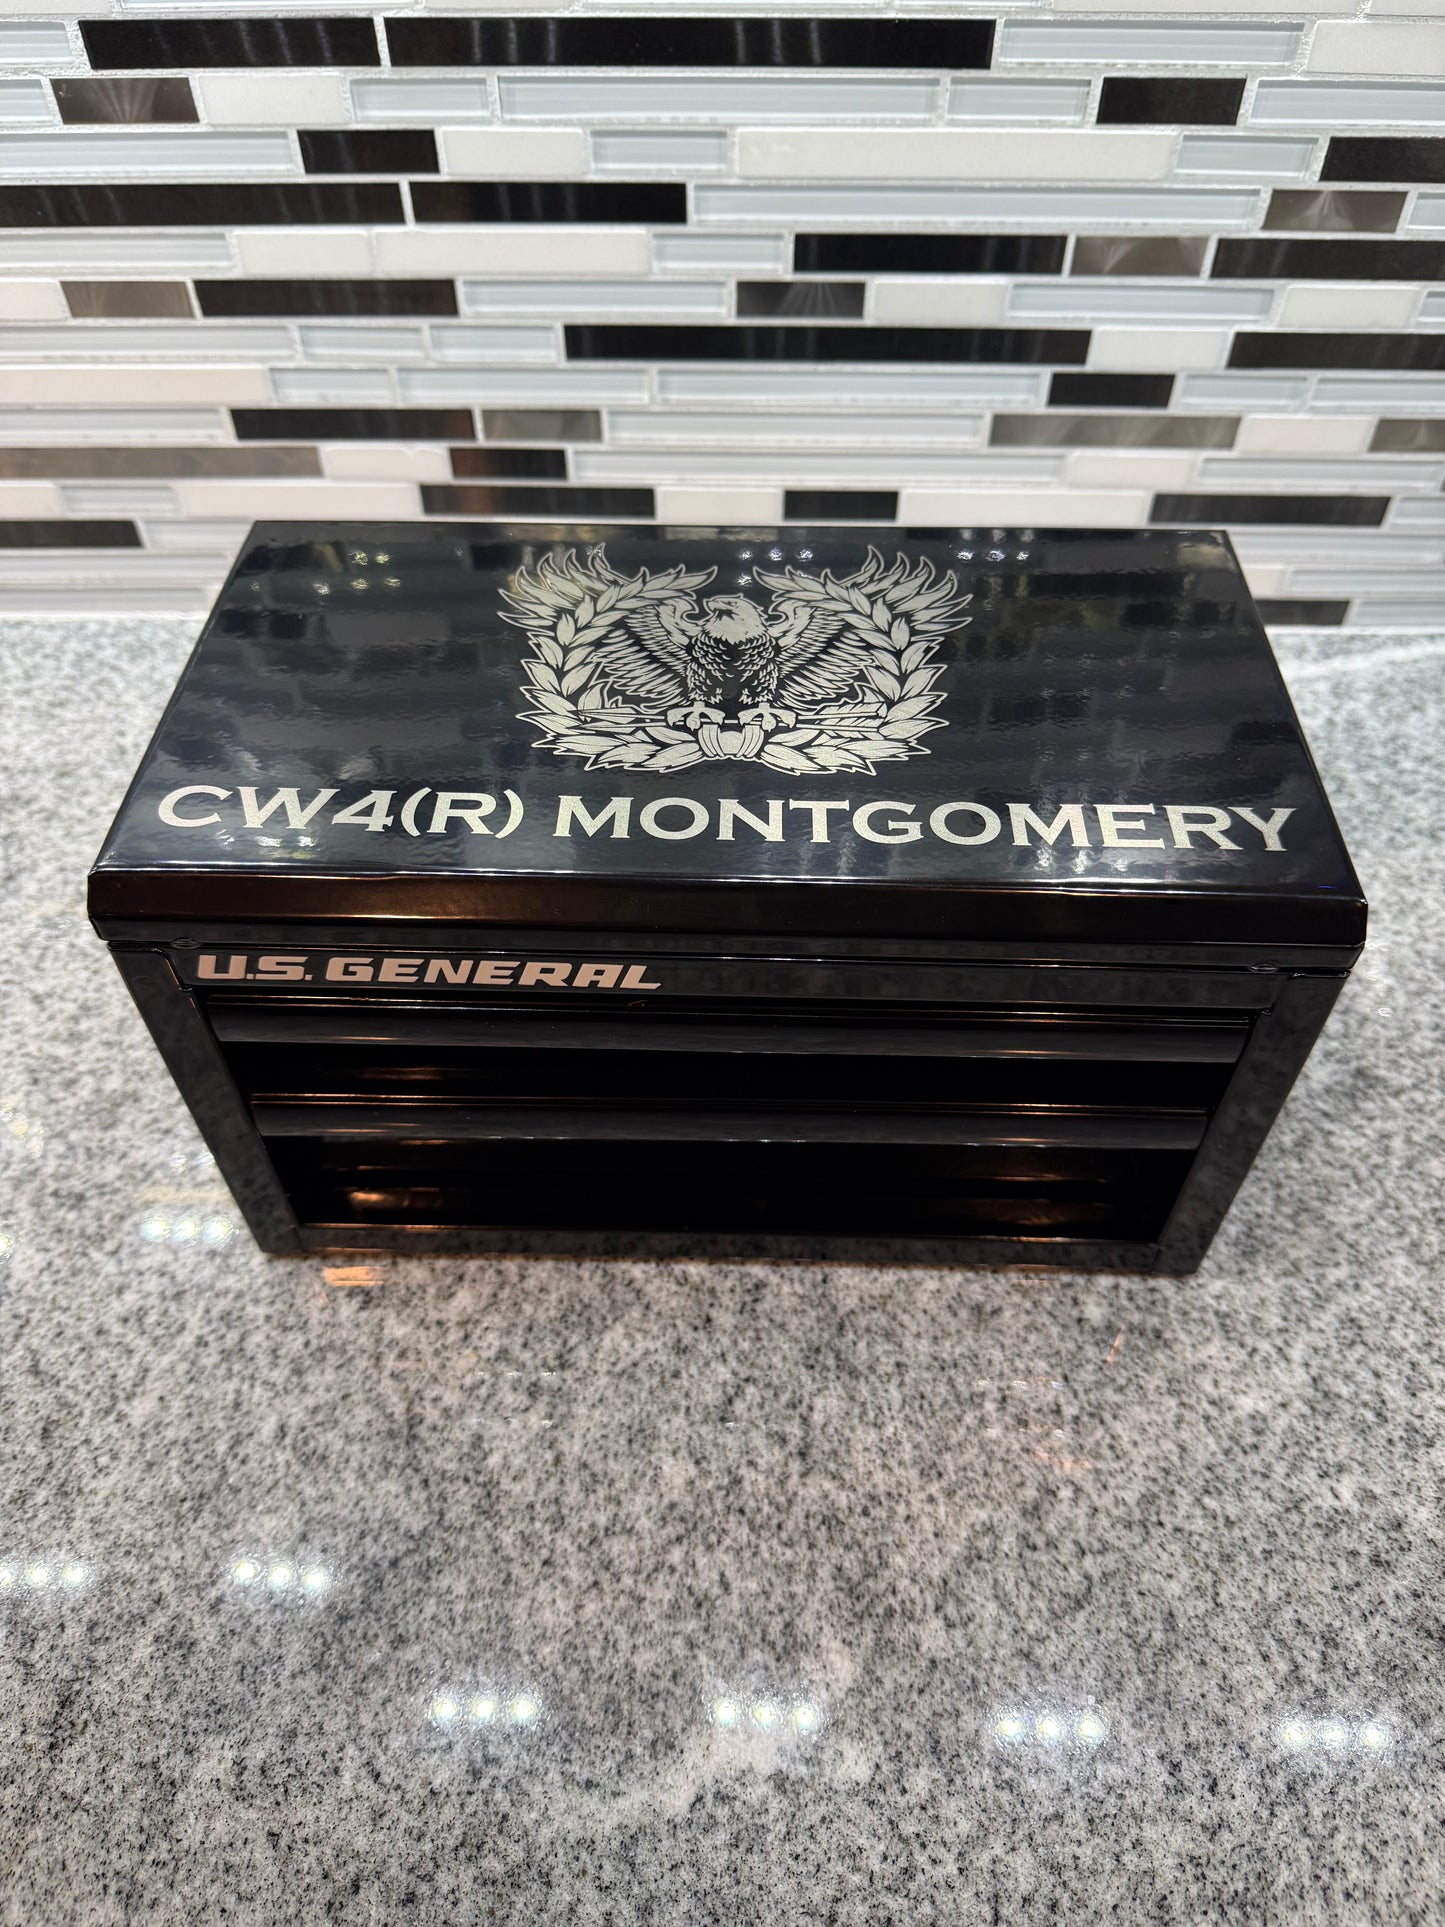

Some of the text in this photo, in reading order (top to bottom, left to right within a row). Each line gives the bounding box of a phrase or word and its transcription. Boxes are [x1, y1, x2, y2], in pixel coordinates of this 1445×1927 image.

[157, 785, 1297, 852] CW4(R) MONTGOMERY
[197, 954, 661, 990] U.S. GENERAL
